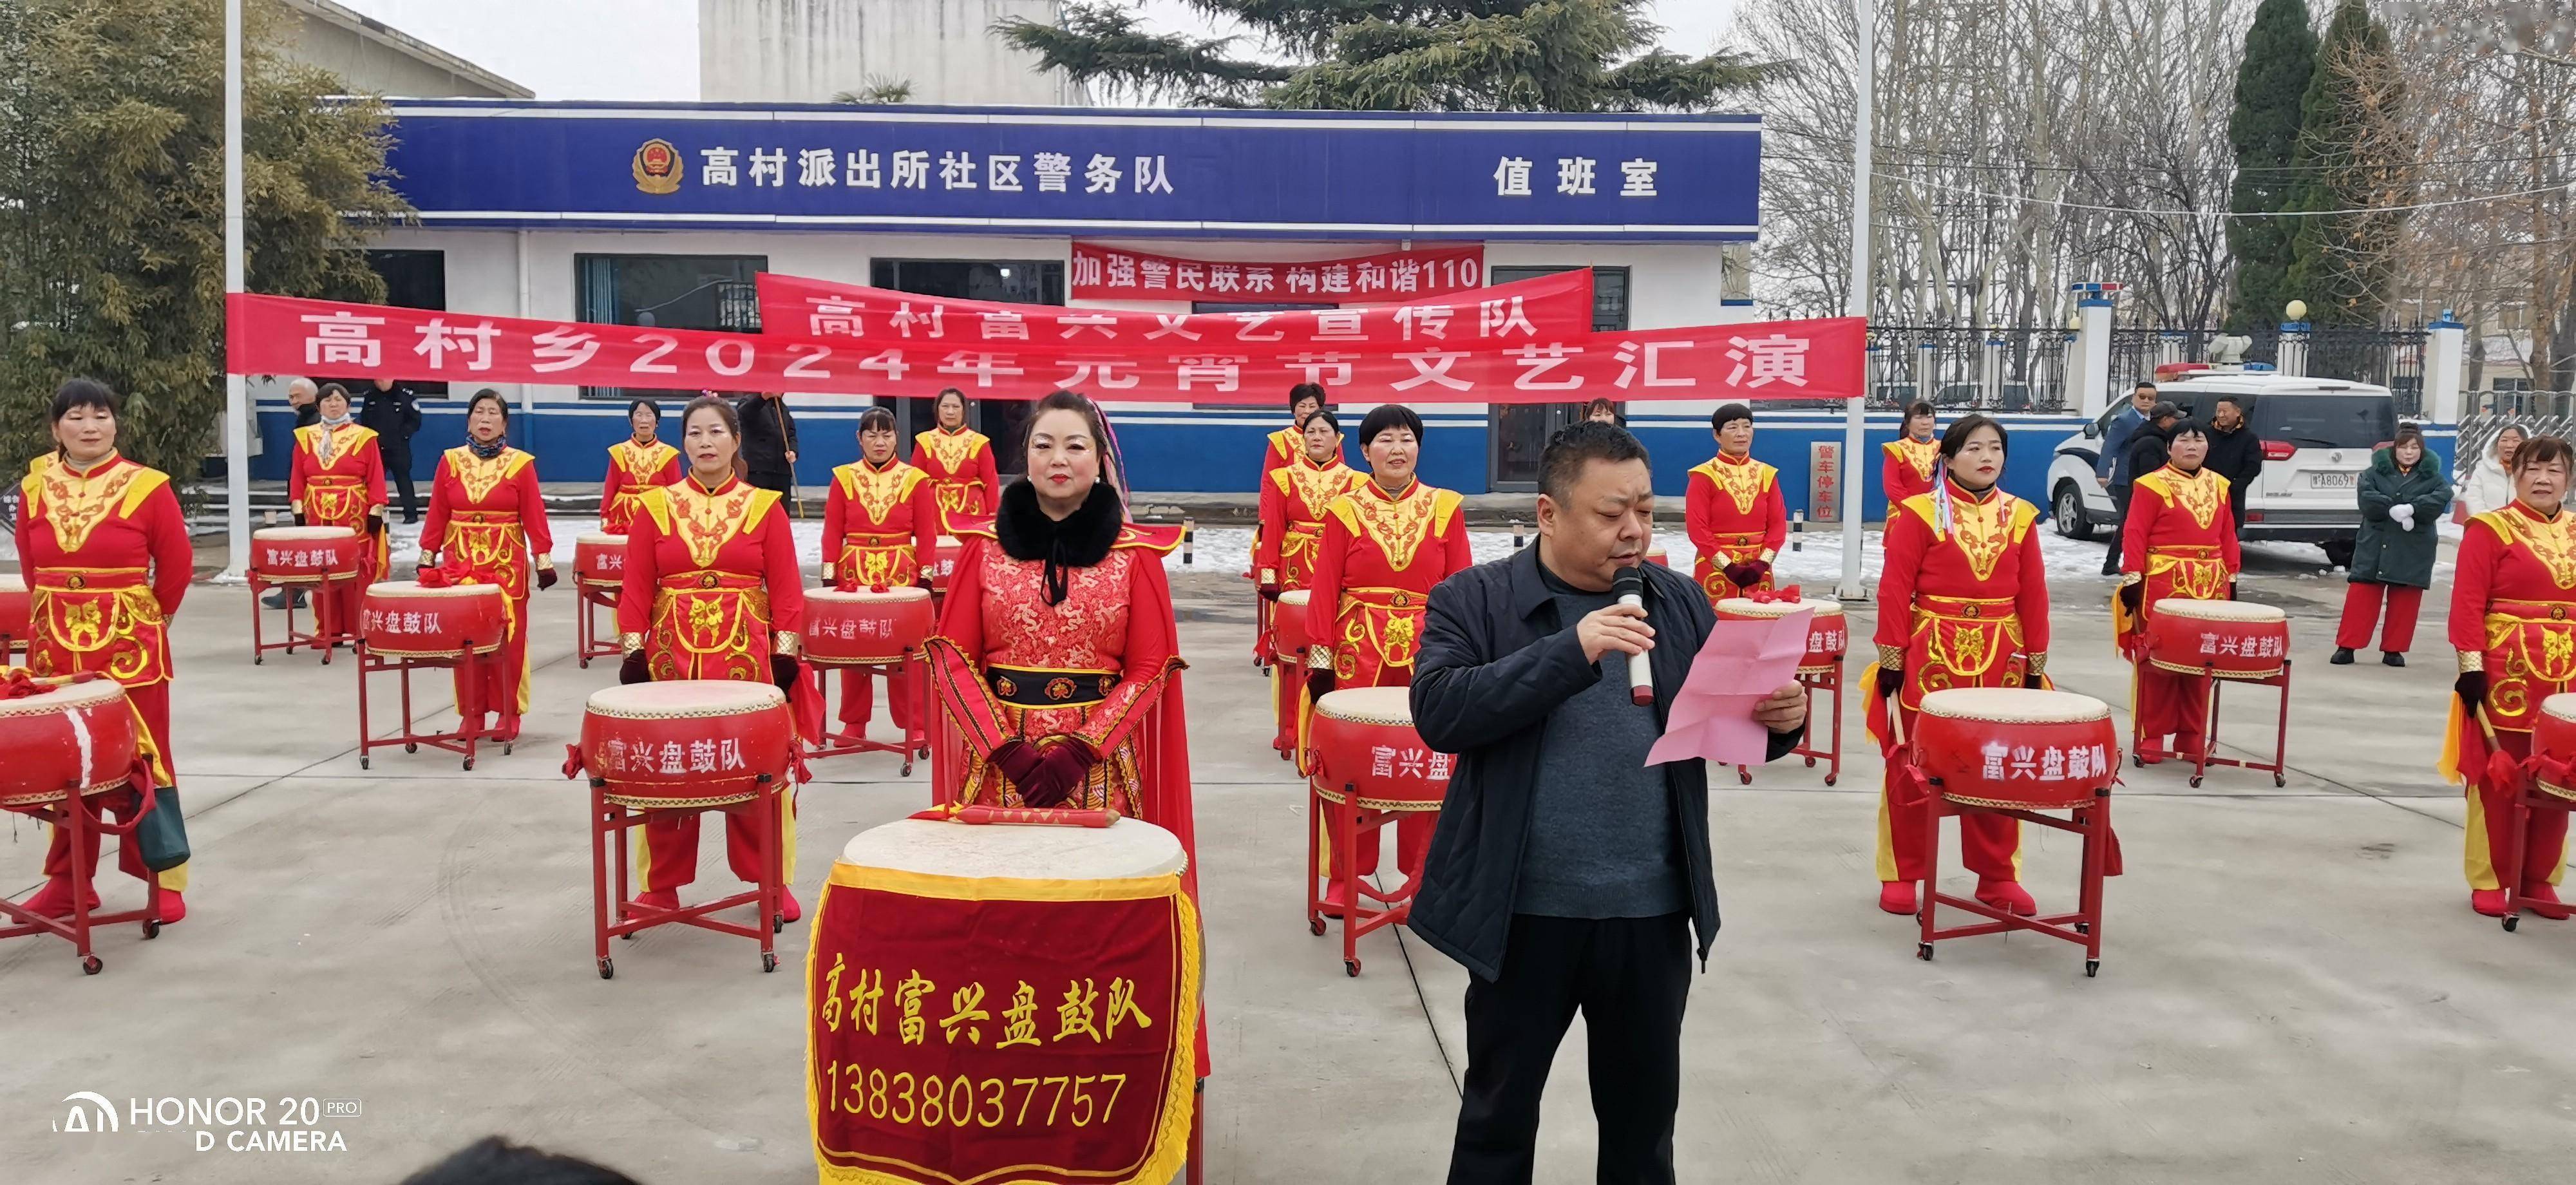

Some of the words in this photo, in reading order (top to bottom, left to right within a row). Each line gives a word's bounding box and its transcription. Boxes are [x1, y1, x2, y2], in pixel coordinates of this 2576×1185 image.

[701, 147, 1174, 194] 高村派出所社区警务队
[1493, 156, 1658, 196] 值班室
[1072, 251, 1275, 293] 加强警民联系
[1285, 258, 1478, 294] 构建和谐110
[301, 312, 1810, 392] 高村乡2024年元宵节文艺汇演
[1817, 445, 1834, 518] 警车停车位
[267, 548, 339, 567] 富兴盘鼓队
[363, 609, 442, 634] 富兴盘鼓队
[2200, 632, 2283, 658] 富兴盘鼓队
[607, 737, 746, 773] 富兴盘鼓队
[1981, 740, 2107, 781] 富兴盘鼓队
[821, 953, 1153, 1049] 高村富兴盘鼓队
[827, 1060, 1126, 1127] 13838037757
